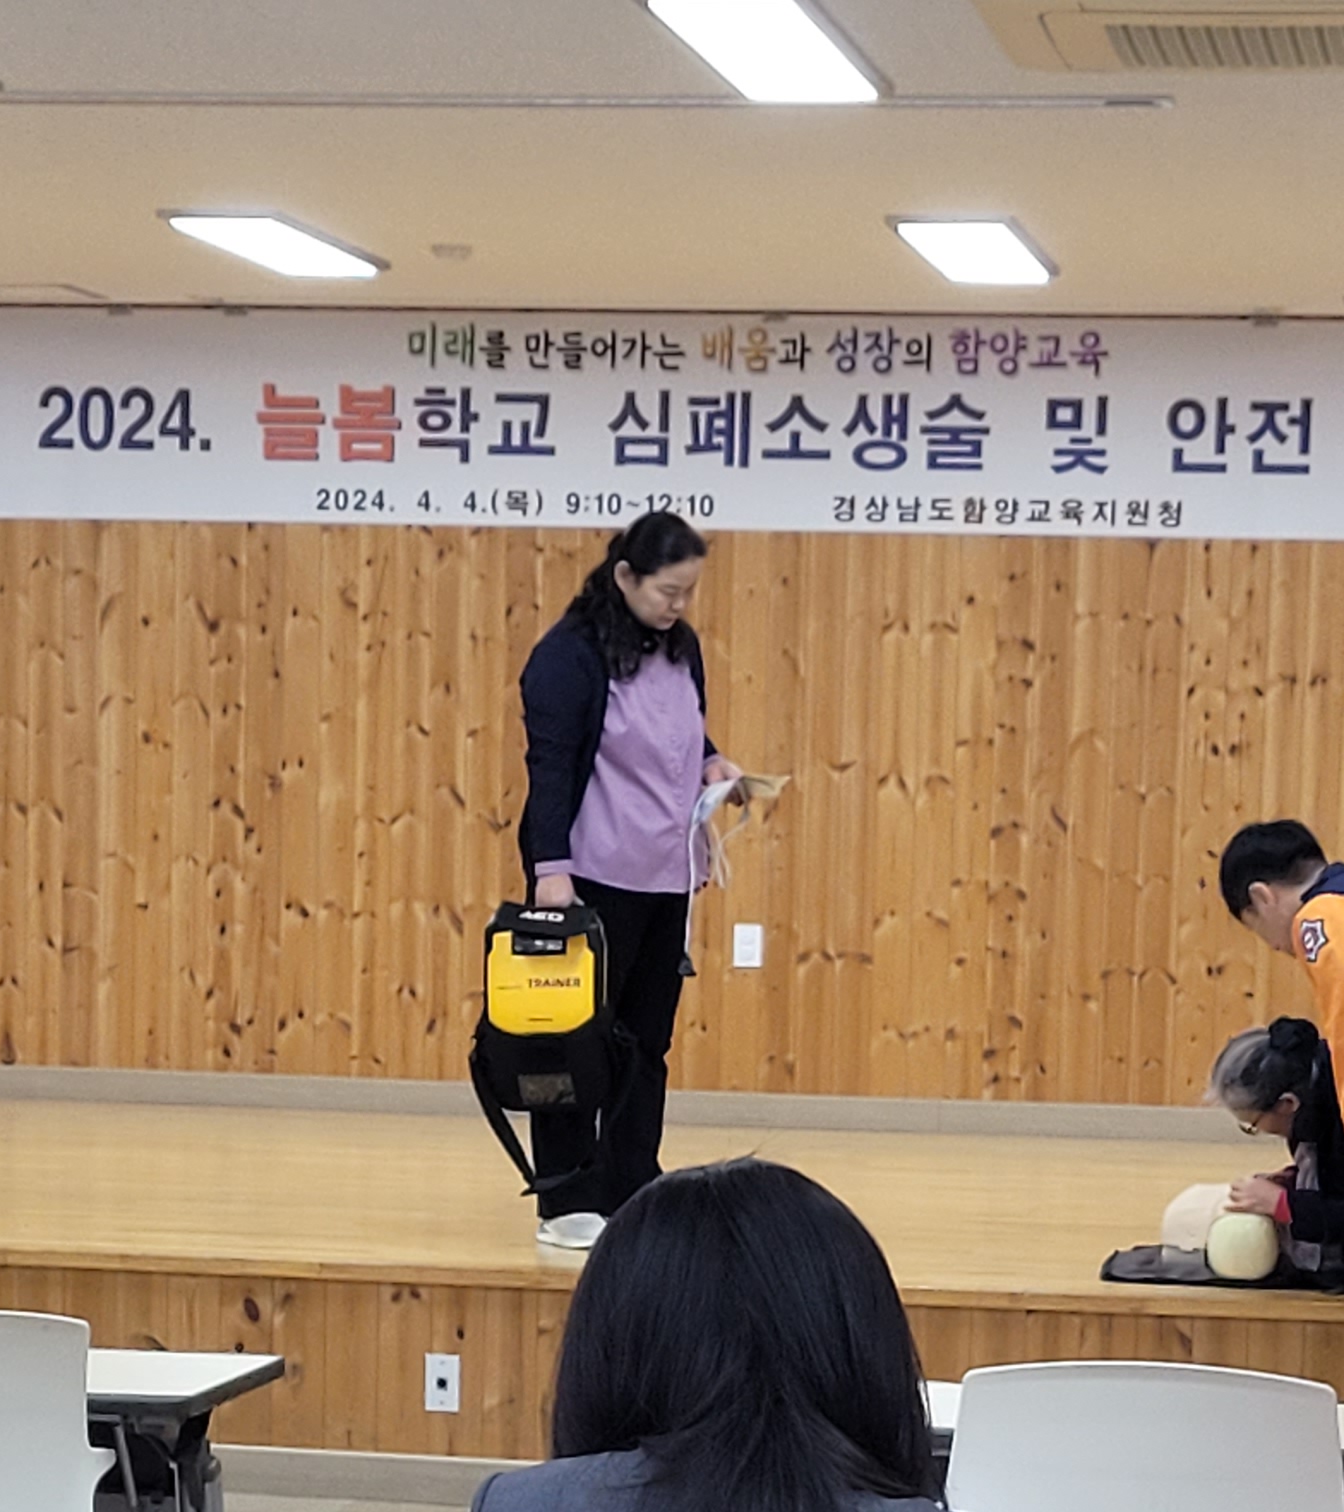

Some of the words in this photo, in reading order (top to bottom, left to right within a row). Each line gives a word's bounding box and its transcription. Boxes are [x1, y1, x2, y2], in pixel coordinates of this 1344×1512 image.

[408, 322, 512, 369] 미래를
[523, 328, 687, 371] 만들어가는
[701, 324, 812, 373] 배움과
[826, 327, 933, 374] 성장의
[948, 329, 1109, 376] 함양교육
[38, 385, 213, 452] 2024.
[255, 382, 557, 467] 늘봄학교
[607, 389, 991, 472] 심폐소생술
[1045, 394, 1110, 475] 및
[1166, 395, 1315, 476] 안전
[315, 488, 396, 514] 2024.
[831, 494, 1184, 528] 경상남도함양교육지원청
[518, 910, 565, 923] AED
[528, 977, 581, 989] TRAINER
